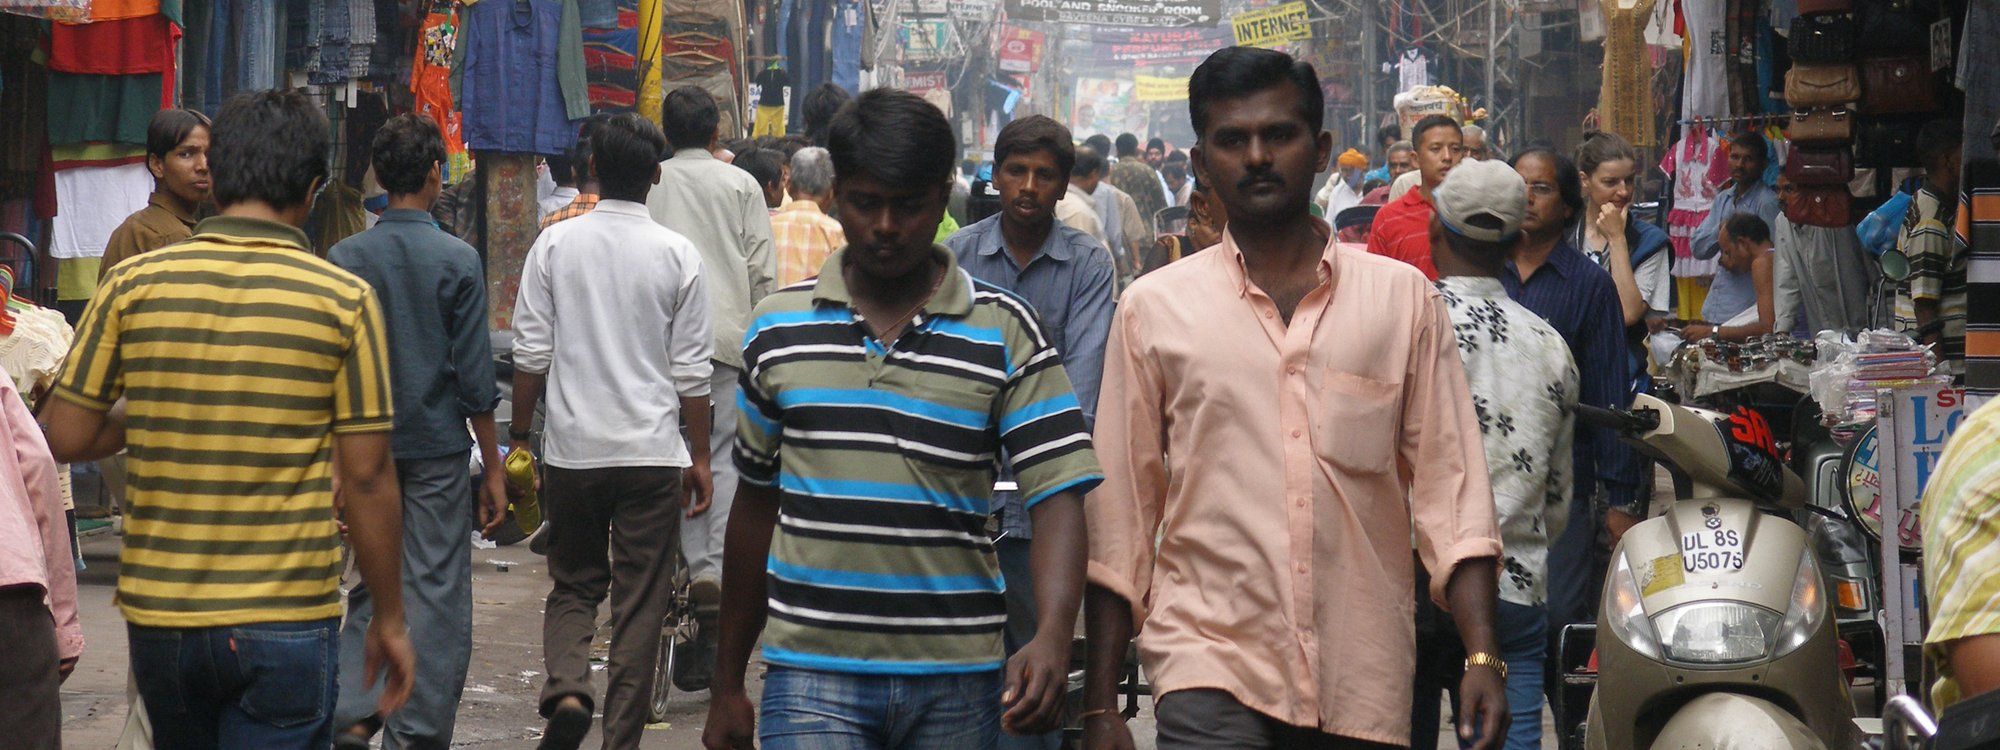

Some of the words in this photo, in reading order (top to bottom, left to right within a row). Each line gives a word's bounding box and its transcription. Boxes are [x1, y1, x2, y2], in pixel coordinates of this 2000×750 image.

[1020, 0, 1056, 8] POOL
[1061, 1, 1091, 11] AND
[1164, 6, 1202, 15] ROOM
[1236, 11, 1307, 42] INTERNET
[1129, 30, 1203, 43] NATURAL
[1714, 529, 1739, 547] 8S
[1683, 551, 1743, 573] U5075
